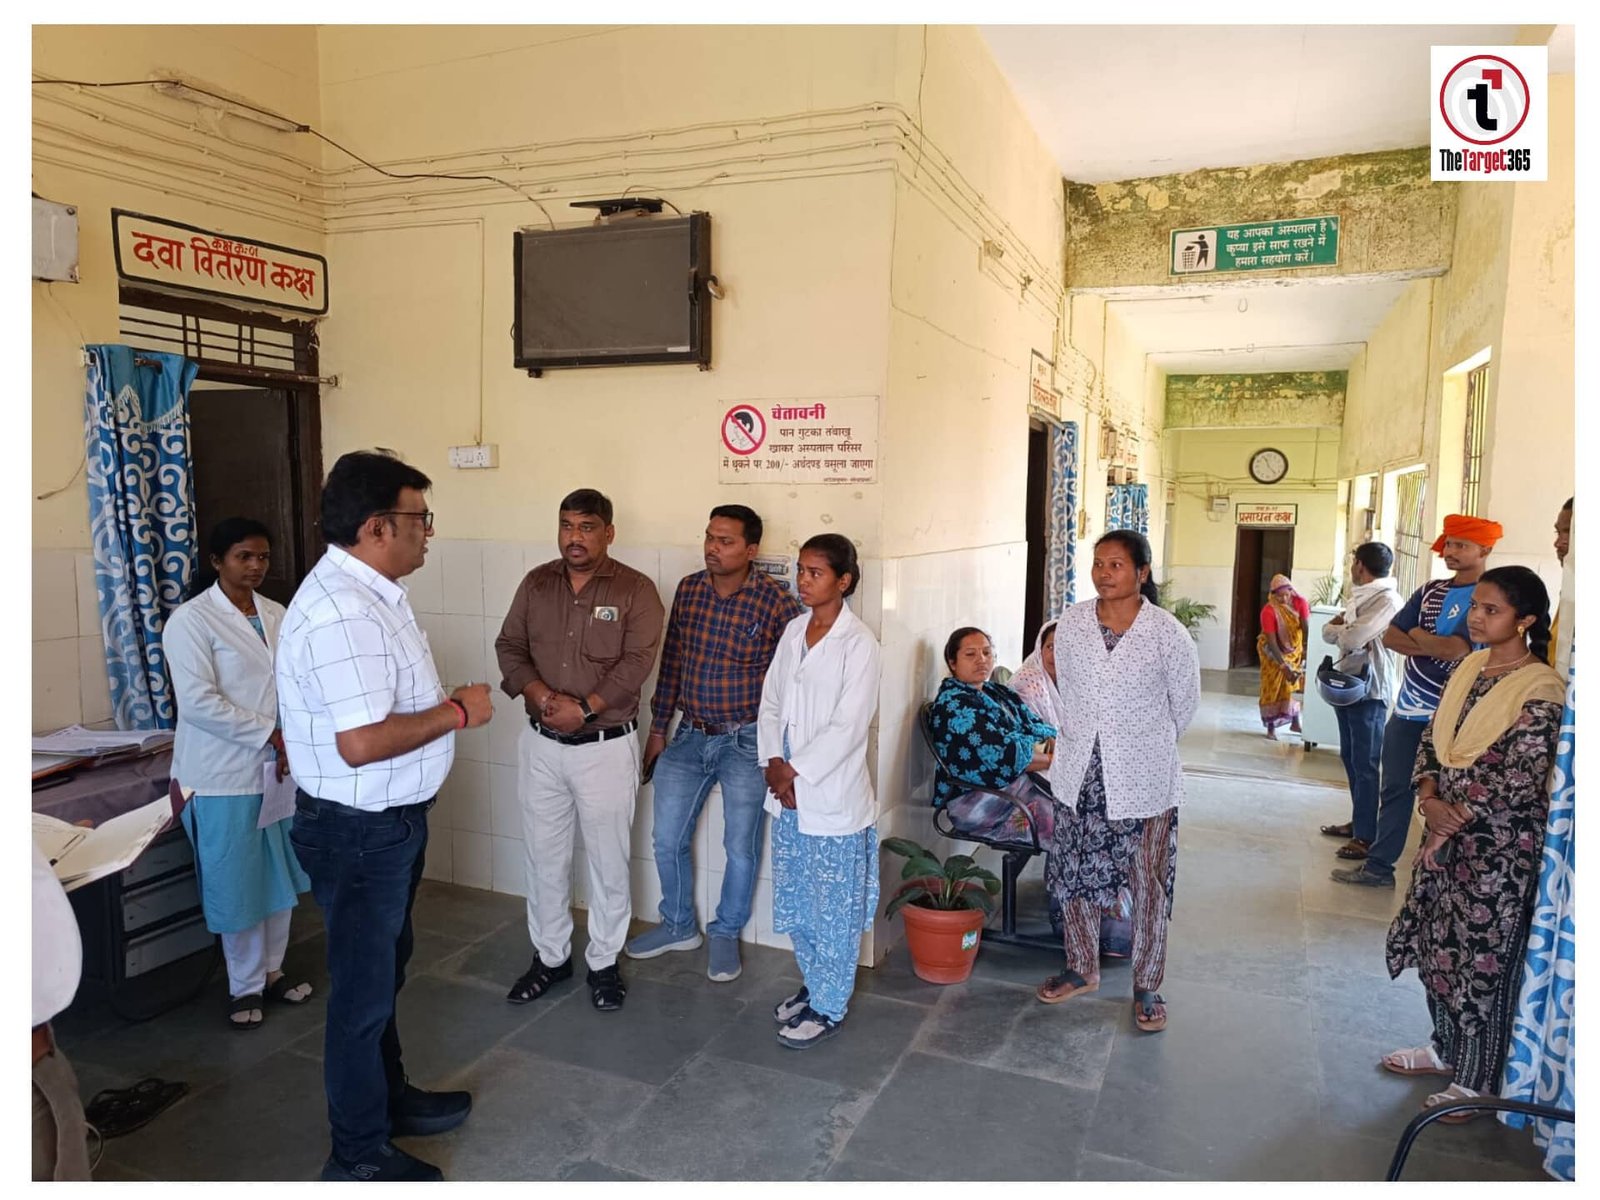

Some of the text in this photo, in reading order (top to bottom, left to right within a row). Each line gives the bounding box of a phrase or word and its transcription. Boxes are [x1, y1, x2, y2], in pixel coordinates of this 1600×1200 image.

[1226, 229, 1240, 240] यह
[1243, 226, 1274, 238] आपका
[1319, 219, 1327, 234] है
[1253, 238, 1266, 254] इसे
[1269, 240, 1290, 250] साफ
[1293, 234, 1314, 247] रखने
[1318, 232, 1327, 246] में
[131, 231, 316, 301] दवा वितरण कक्ष
[1235, 256, 1258, 267] हमारा
[1261, 250, 1292, 265] सहयोग
[771, 403, 826, 420] चेतावनी
[780, 428, 794, 437] पान
[798, 428, 822, 440] गुटका
[768, 440, 862, 453] खाकर अस्पताल परिसर
[754, 460, 762, 469] पर
[824, 459, 847, 473] वसूला
[850, 459, 874, 471] जाएगा
